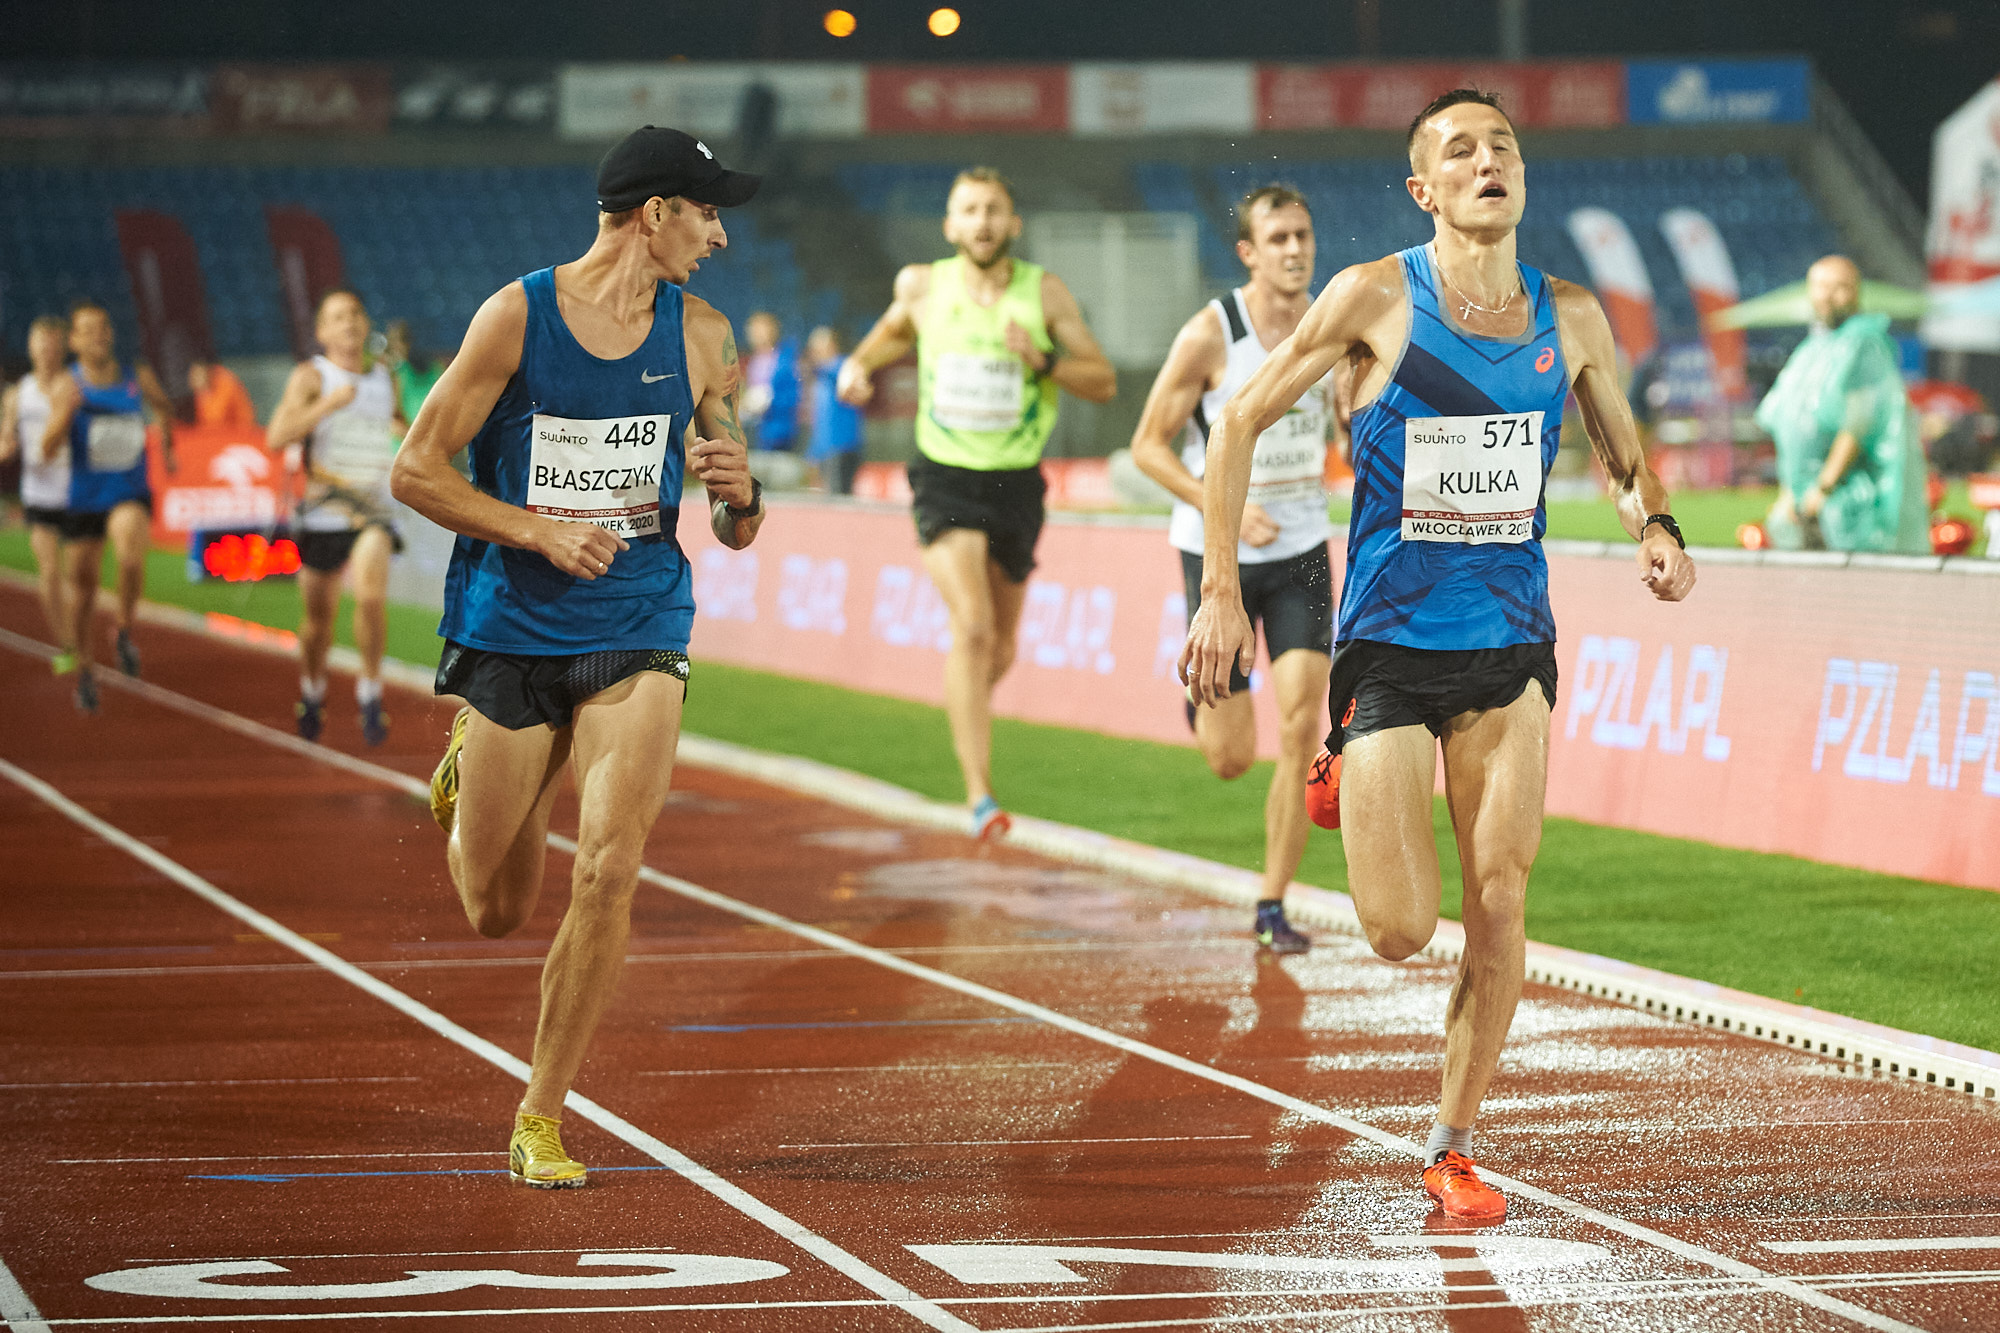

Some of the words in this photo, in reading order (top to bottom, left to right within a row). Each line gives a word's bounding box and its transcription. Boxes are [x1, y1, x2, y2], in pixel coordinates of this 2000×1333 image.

[540, 431, 588, 445] SUUNTO
[604, 420, 657, 449] 448
[1414, 434, 1466, 444] SUUNTO
[1482, 418, 1534, 449] 571
[534, 463, 657, 492] BŁASZCZYK
[1439, 469, 1519, 494] KULKA
[551, 508, 573, 517] PZLA
[574, 509, 631, 517] MISTRZOSTWA
[1428, 511, 1452, 519] PZLA
[629, 515, 654, 530] 2020
[1411, 521, 1504, 537] WŁOCŁAWEK
[84, 1253, 791, 1300] 3
